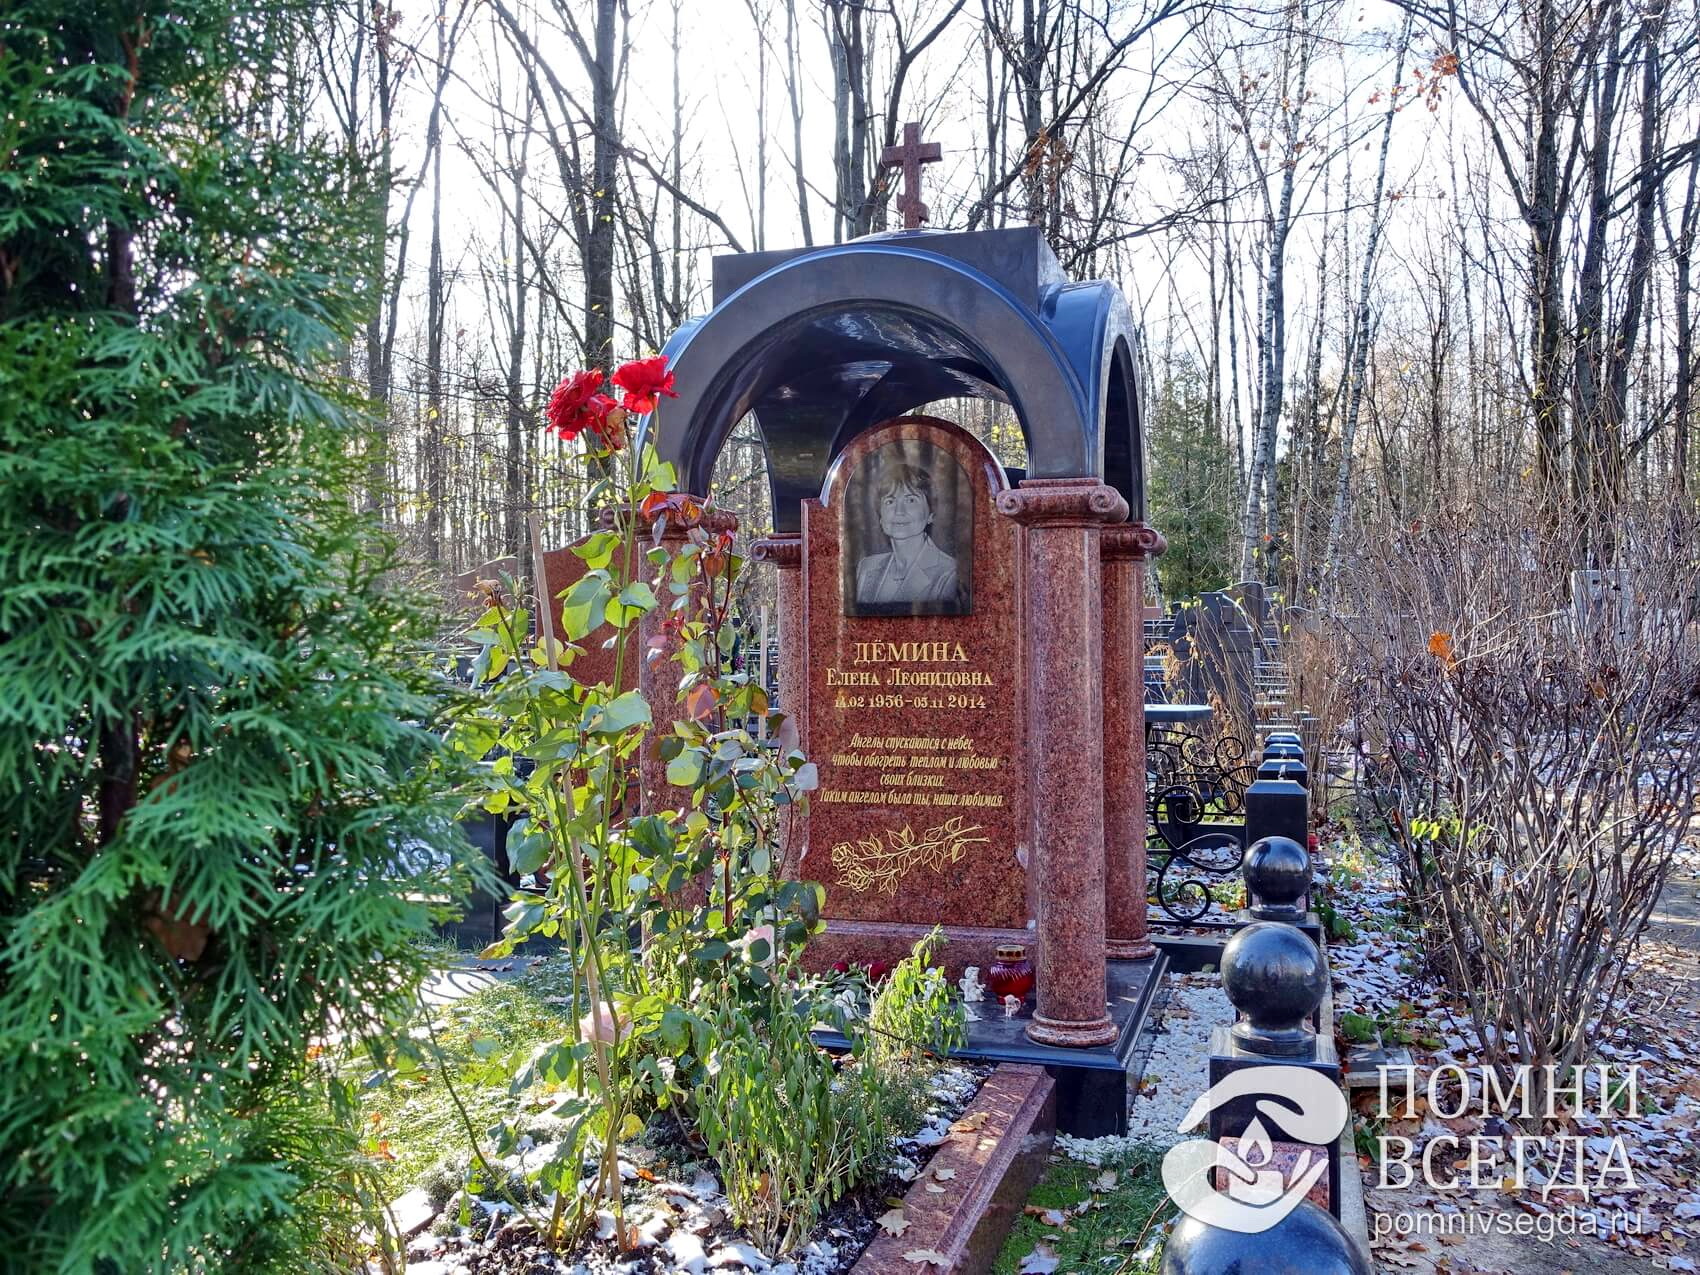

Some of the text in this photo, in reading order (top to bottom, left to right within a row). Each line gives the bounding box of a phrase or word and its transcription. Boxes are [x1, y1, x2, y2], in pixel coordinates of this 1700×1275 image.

[854, 639, 969, 666] ДЁМИНА
[948, 694, 986, 709] 2014
[849, 732, 974, 753] Ангелы спускаются с небес,
[832, 752, 997, 770] чтобы обогреть теплом и любовью
[880, 774, 905, 785] своих
[820, 788, 847, 802] Таким
[848, 791, 886, 803] ангелом
[888, 789, 912, 804] была
[933, 793, 958, 806] наша
